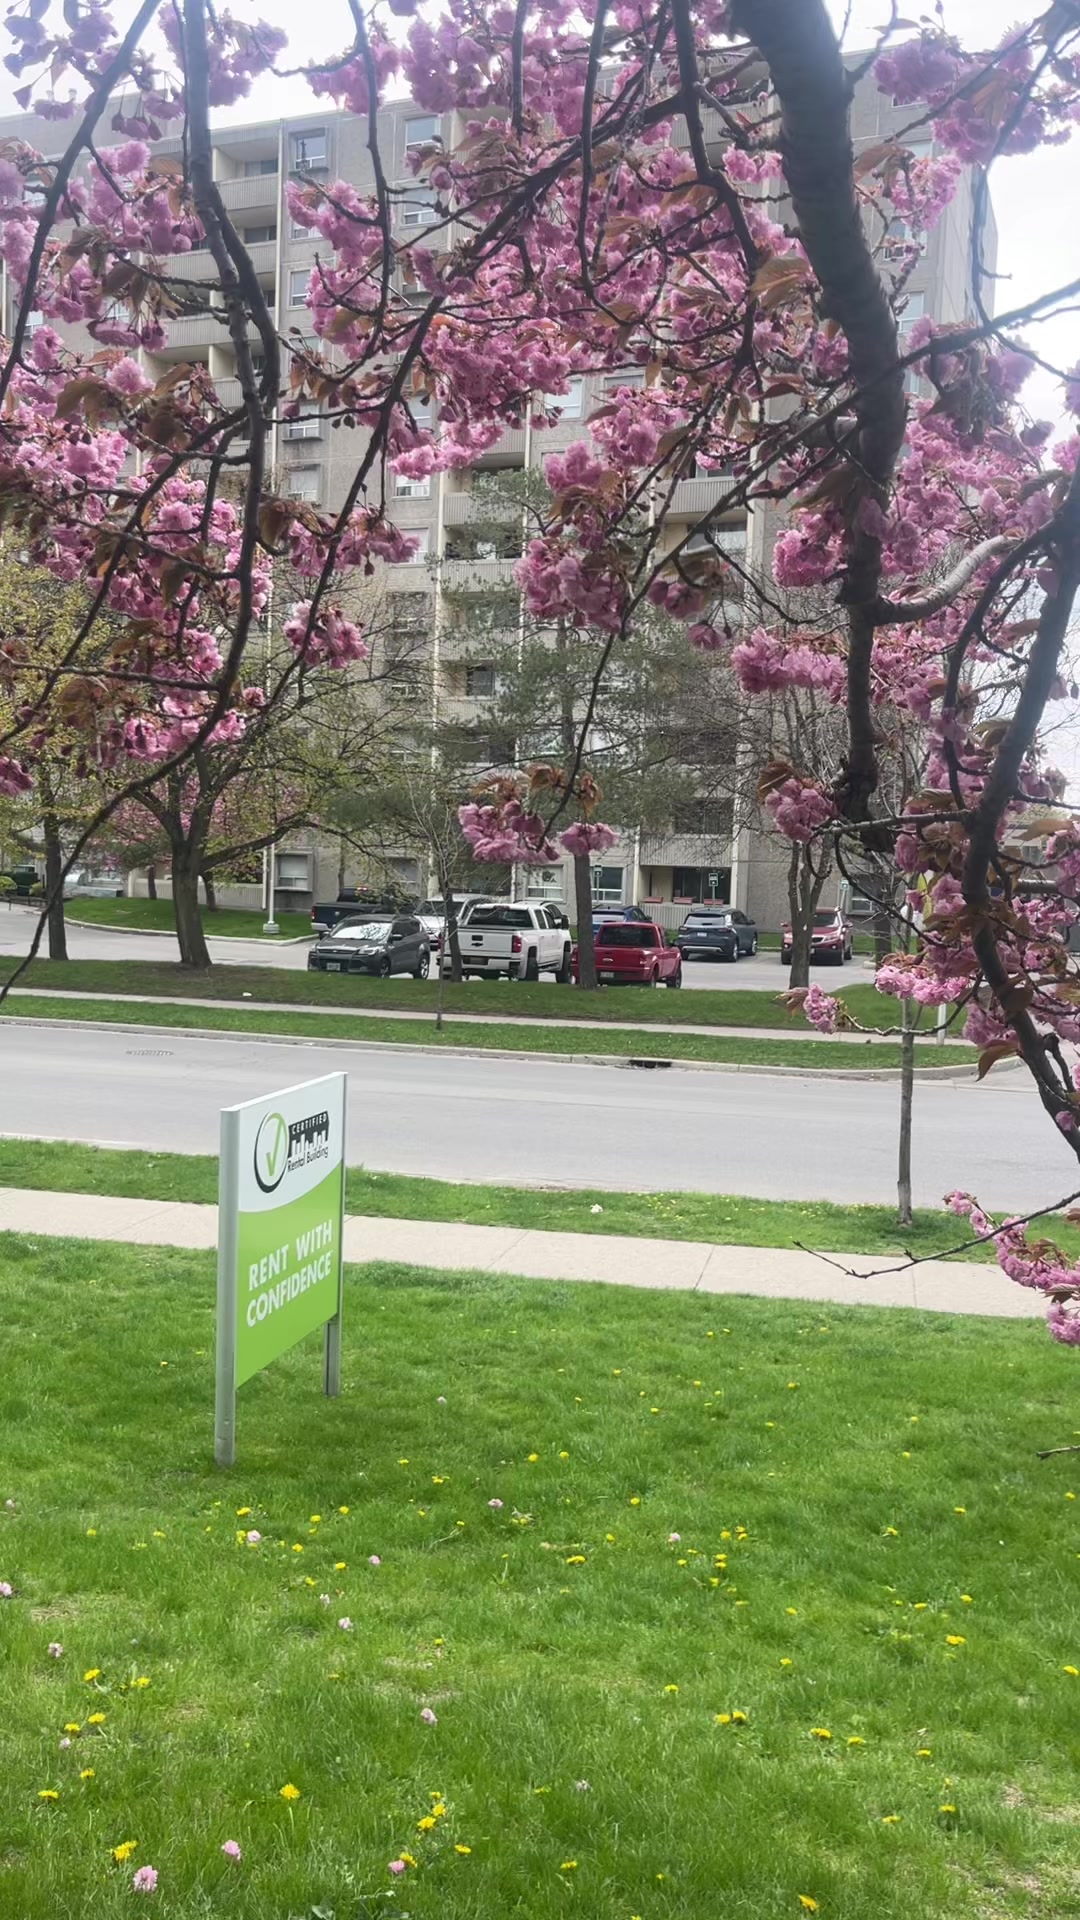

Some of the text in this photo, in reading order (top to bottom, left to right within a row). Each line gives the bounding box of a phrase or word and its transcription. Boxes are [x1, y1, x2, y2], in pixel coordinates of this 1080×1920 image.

[292, 1113, 327, 1134] CERTIFIED
[288, 1146, 328, 1172] Rental Building
[249, 1219, 332, 1291] RENT WITH
[246, 1250, 333, 1327] CONFIDENCE
